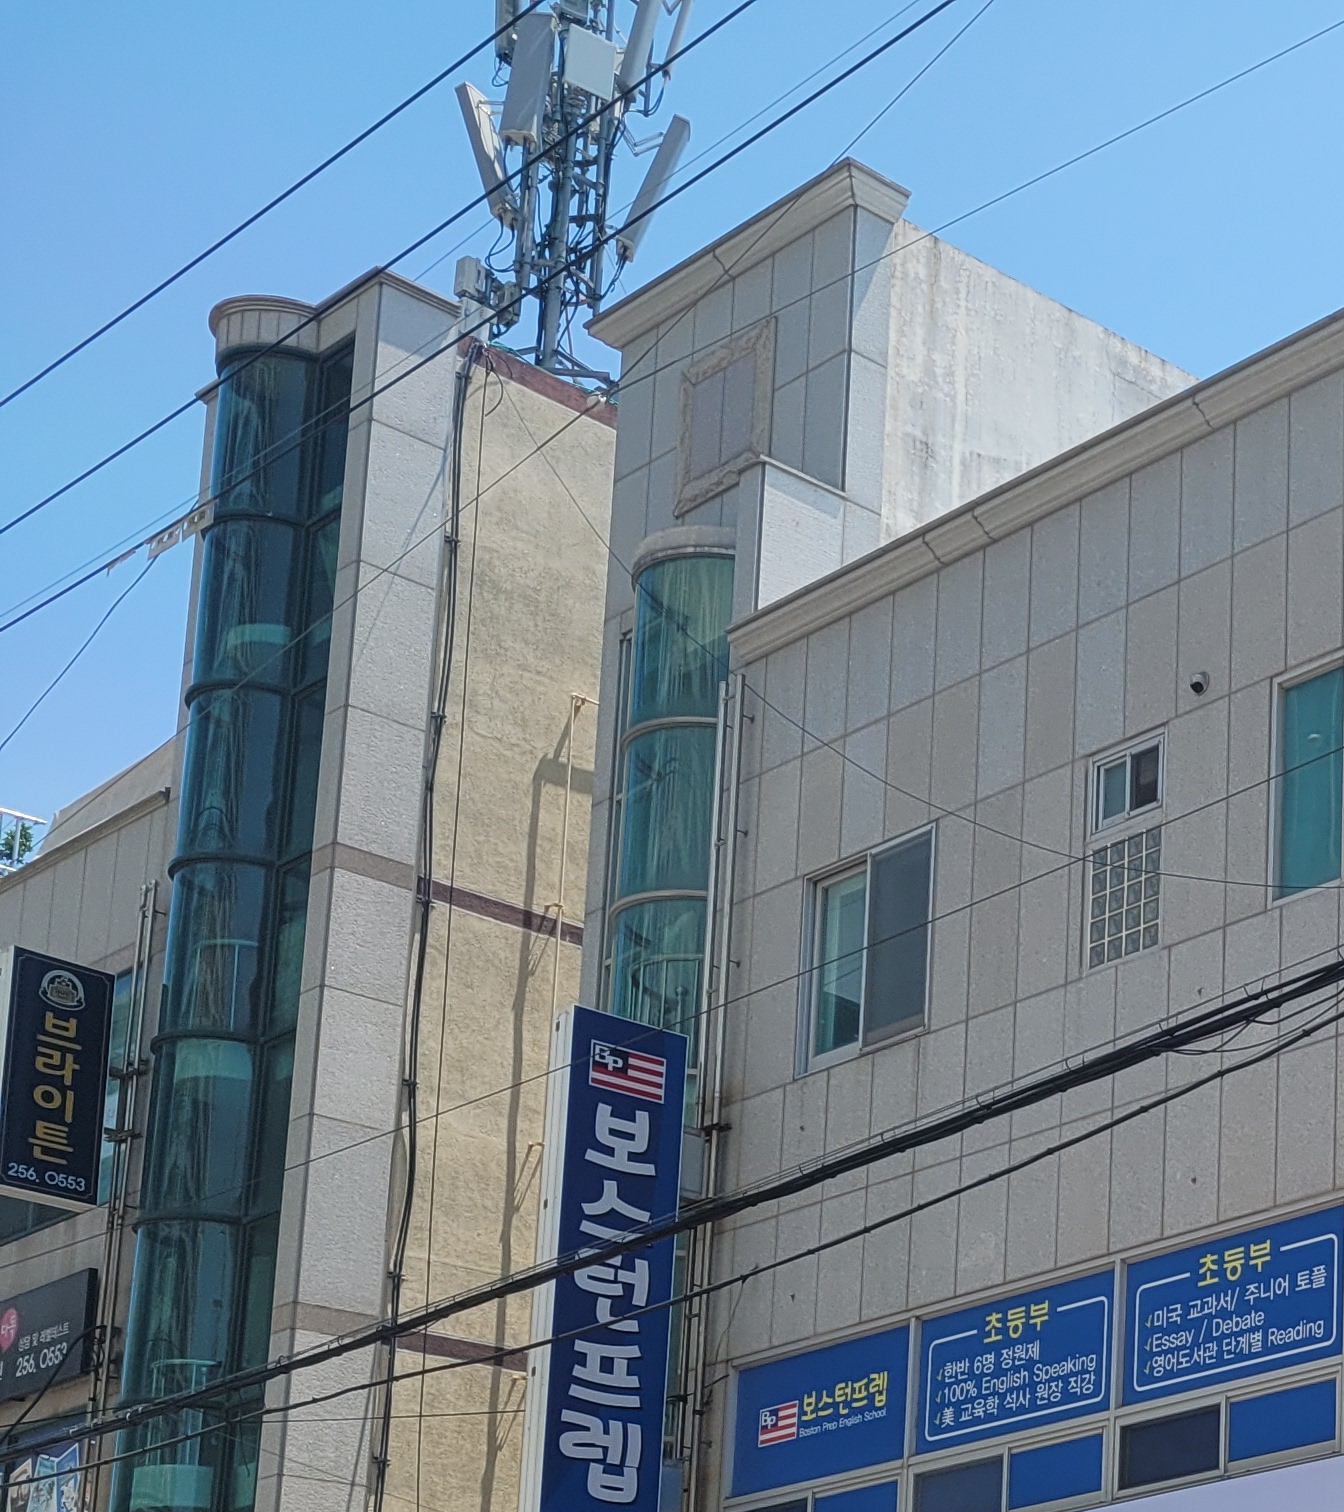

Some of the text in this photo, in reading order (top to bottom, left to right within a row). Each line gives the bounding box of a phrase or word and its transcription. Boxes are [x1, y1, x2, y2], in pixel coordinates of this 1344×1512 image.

[28, 1010, 83, 1165] 브라이튼
[1197, 1239, 1271, 1287] 초등부
[558, 1101, 657, 1503] 보스턴프렙
[983, 1300, 1049, 1343] 초등부
[1153, 1303, 1183, 1328] 미국
[1244, 1274, 1290, 1305] 주니어
[1295, 1264, 1327, 1291] 토플
[1152, 1329, 1194, 1352] Essay
[1212, 1311, 1265, 1337] Debate
[1152, 1319, 1324, 1377] 영어도서관 단계별 Reading
[943, 1339, 1040, 1383] 한반 6명 정원제
[943, 1353, 1097, 1404] 100% English Speaking
[800, 1370, 889, 1421] 보스턴프렙
[941, 1371, 1096, 1429] 美 교육학 석사 원장 직강
